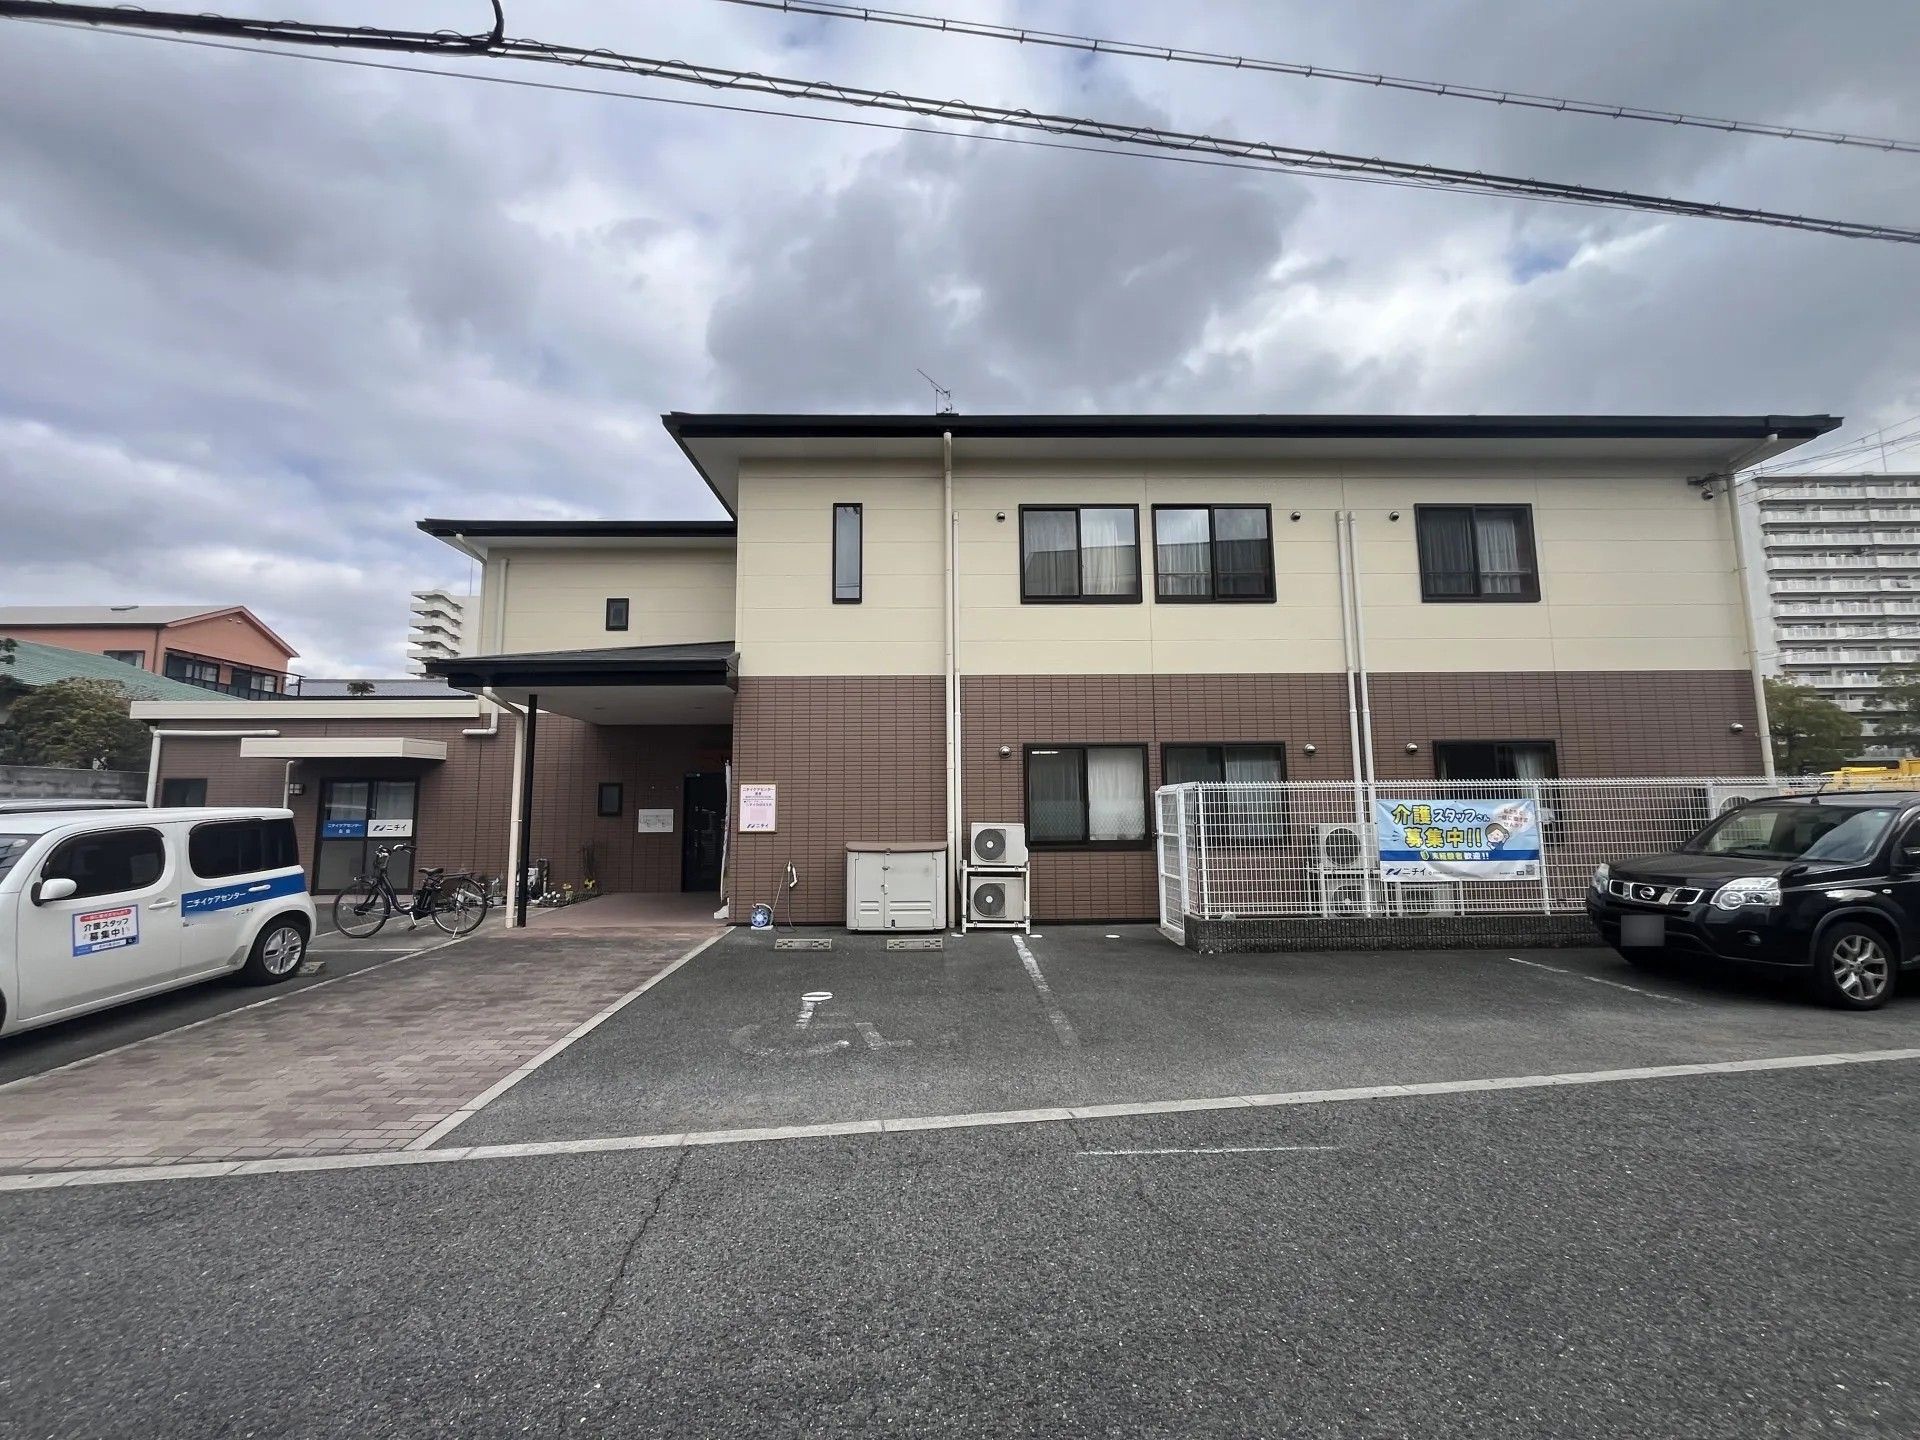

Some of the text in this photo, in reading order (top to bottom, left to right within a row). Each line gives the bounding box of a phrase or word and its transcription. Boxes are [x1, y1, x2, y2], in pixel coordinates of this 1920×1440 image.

[1391, 804, 1490, 825] 介護スタッフさん
[386, 824, 407, 832] ニチイ
[1404, 827, 1482, 848] 募集中!!
[186, 892, 247, 908] ニチイケアセンター
[84, 918, 129, 932] 介護スタッフ
[89, 927, 125, 942] 募集中!
